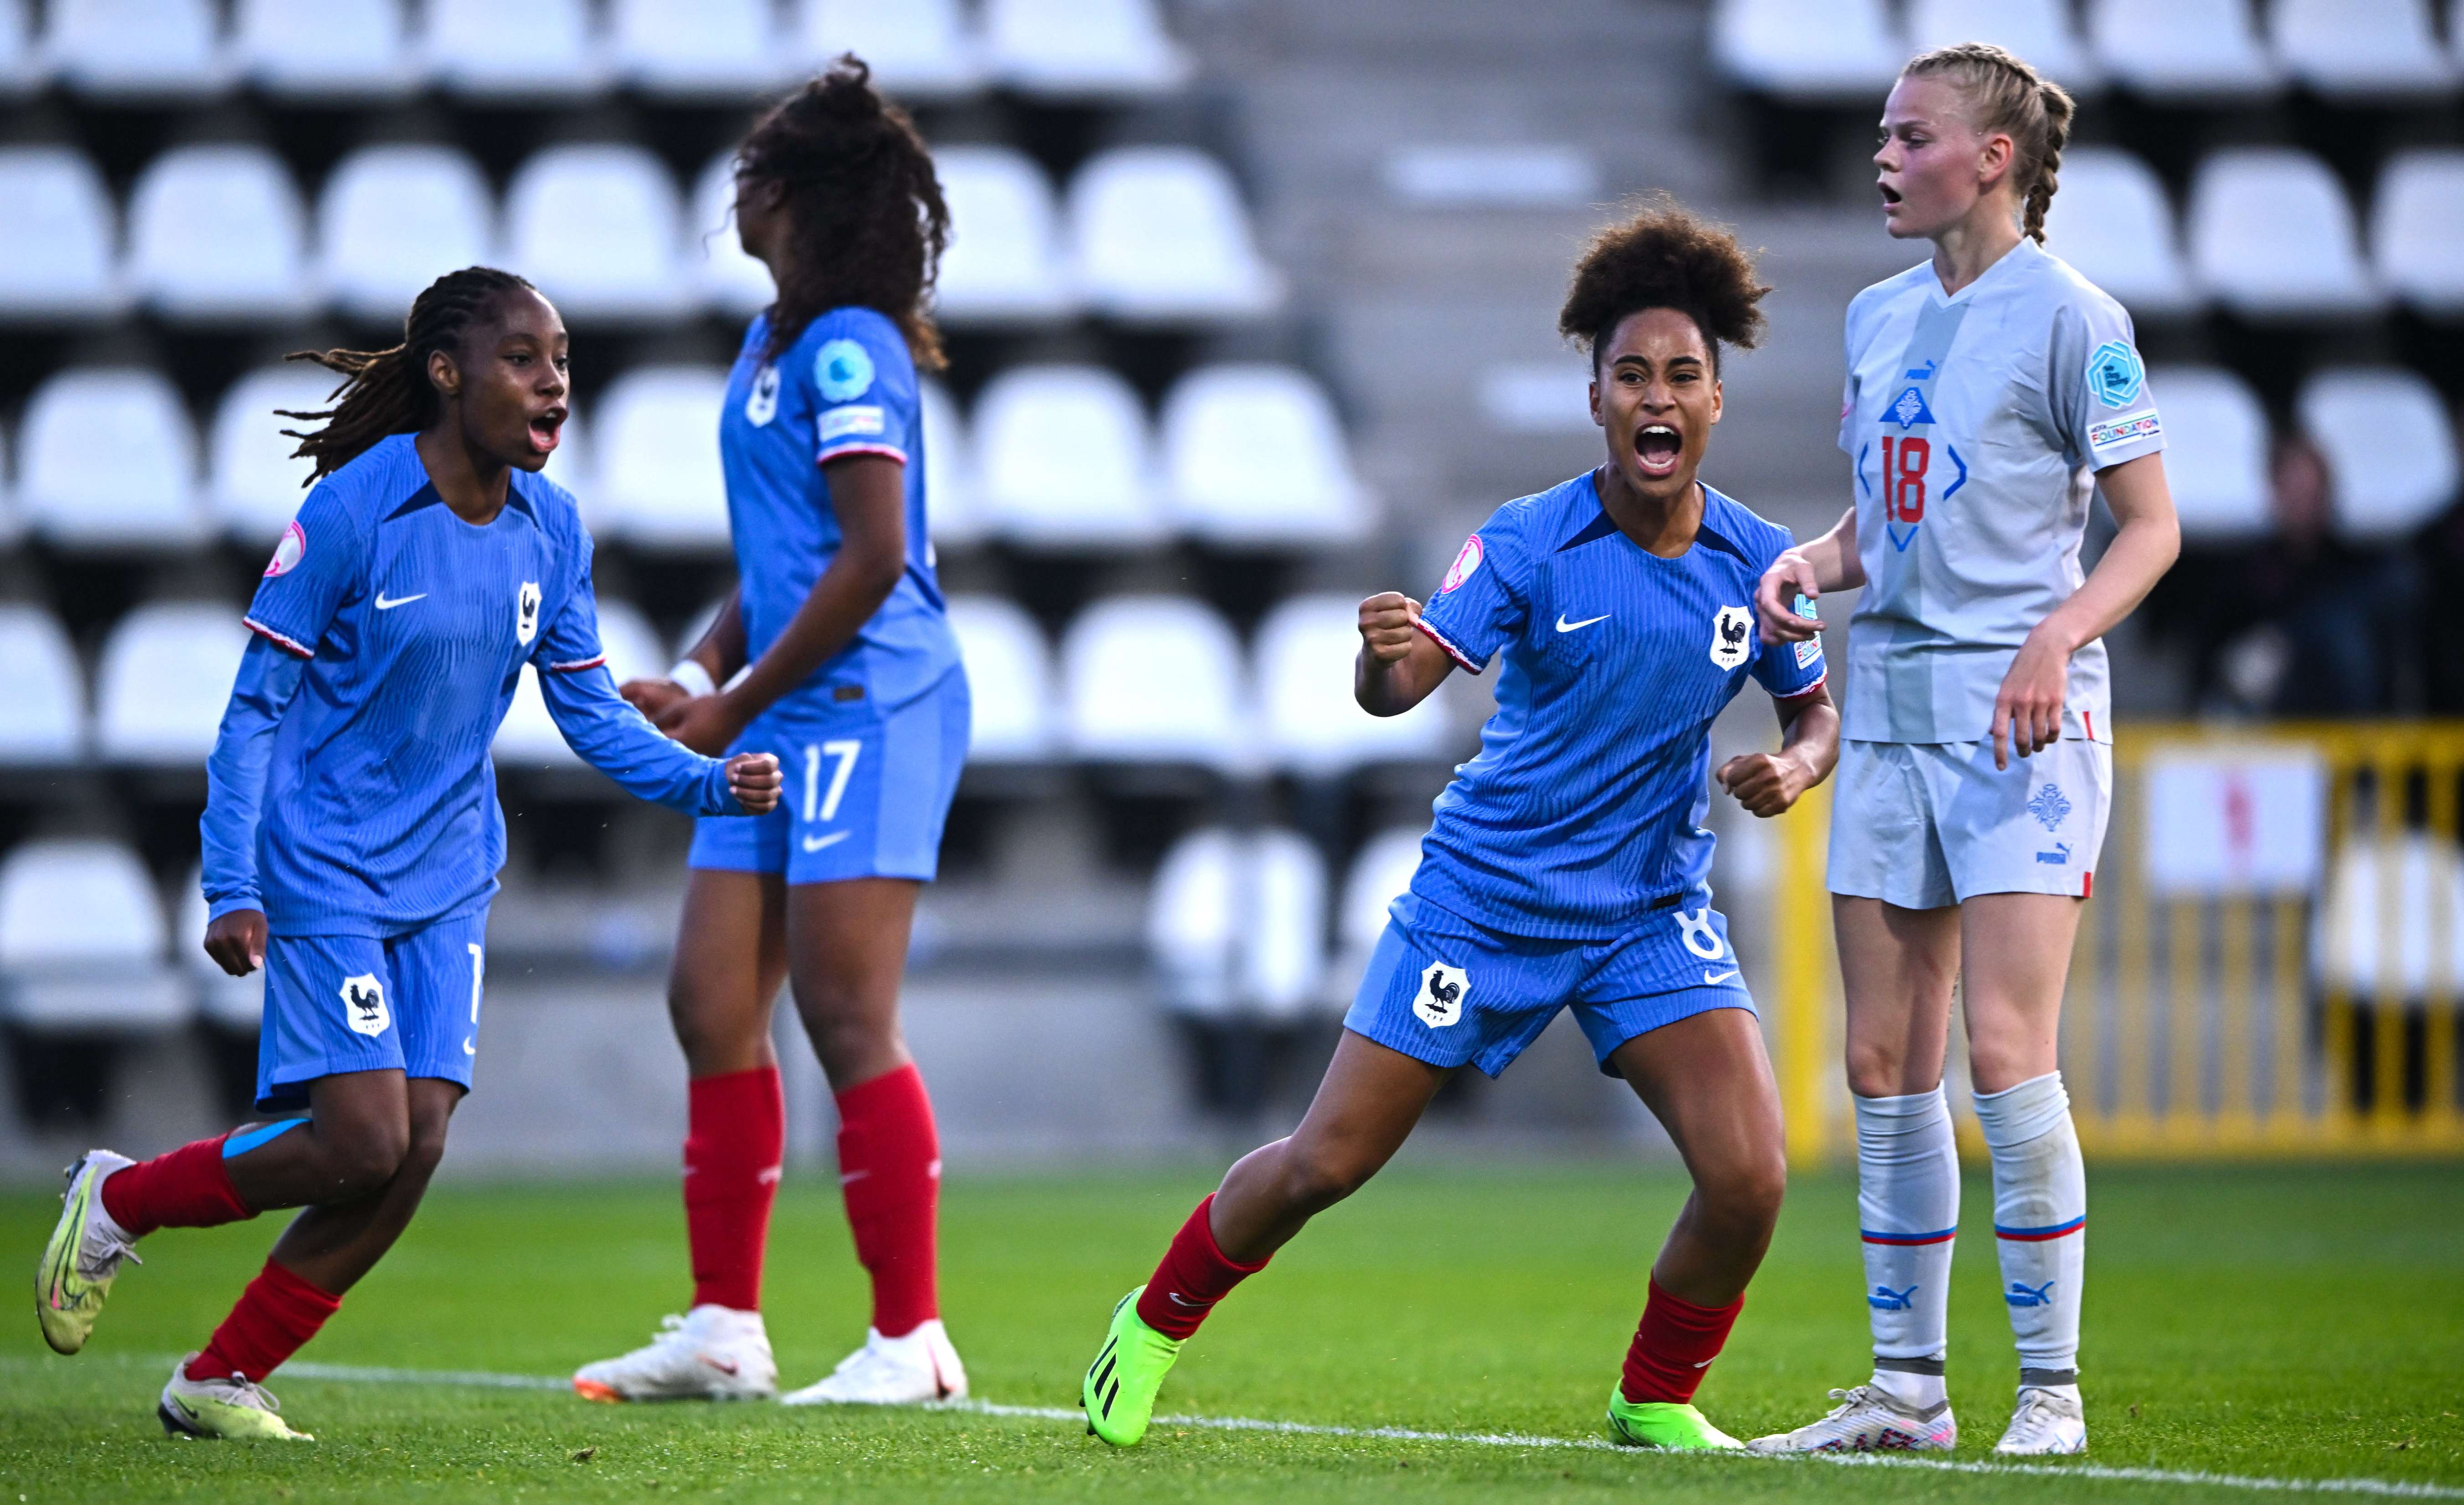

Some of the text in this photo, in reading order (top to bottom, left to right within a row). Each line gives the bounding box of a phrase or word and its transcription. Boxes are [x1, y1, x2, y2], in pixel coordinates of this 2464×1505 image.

[1882, 436, 1931, 524] 18
[803, 739, 862, 822] 17
[1672, 908, 1724, 960] 8
